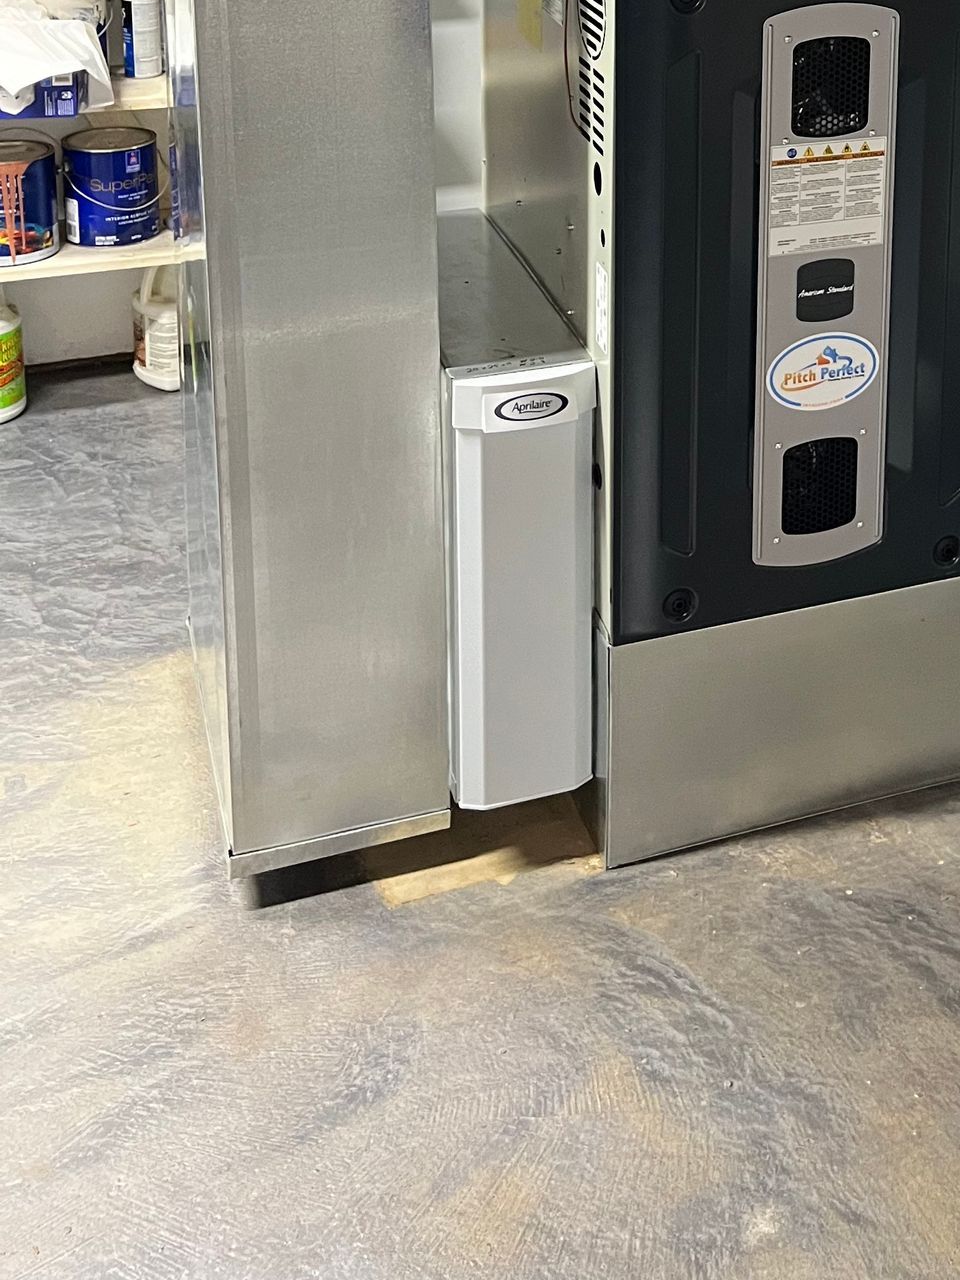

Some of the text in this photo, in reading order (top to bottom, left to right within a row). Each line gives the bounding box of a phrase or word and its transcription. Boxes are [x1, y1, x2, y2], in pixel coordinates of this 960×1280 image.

[784, 362, 865, 385] Pitch Perfect
[511, 400, 551, 414] Aprilaire
